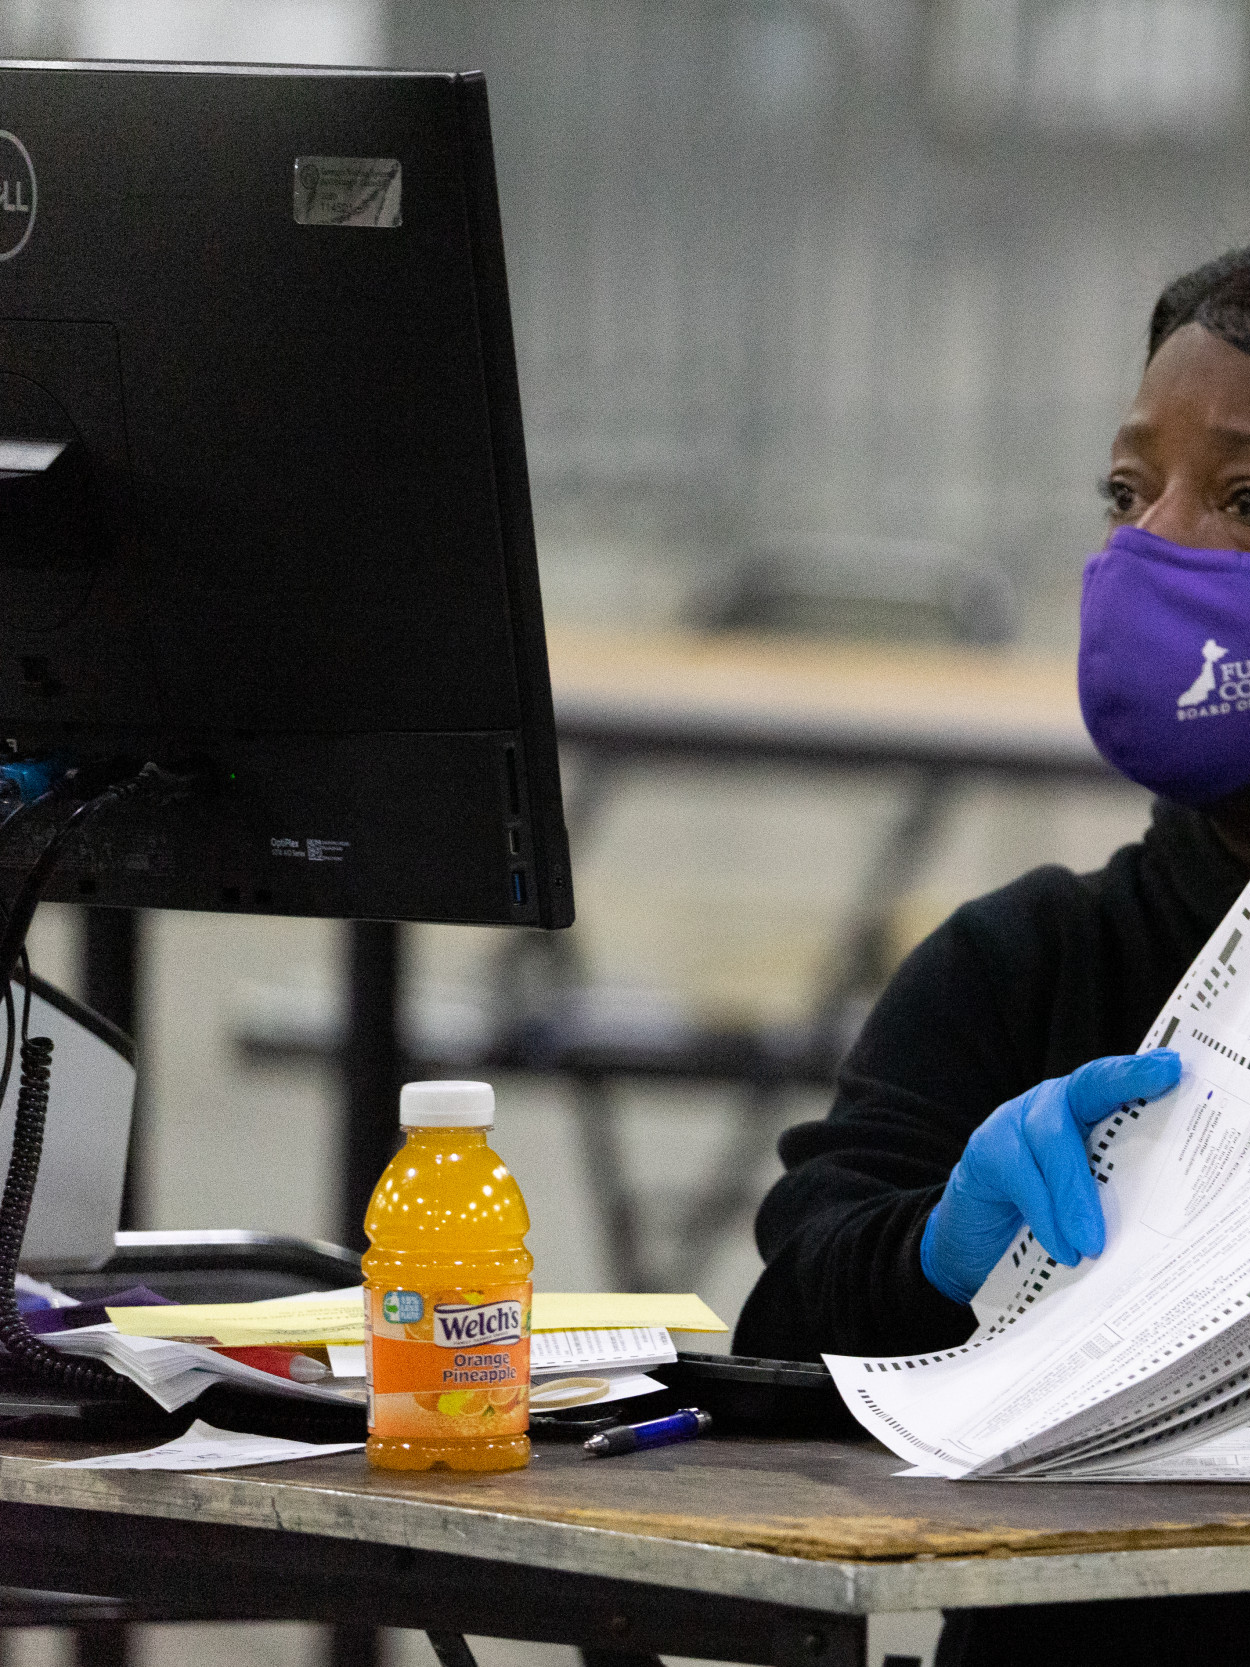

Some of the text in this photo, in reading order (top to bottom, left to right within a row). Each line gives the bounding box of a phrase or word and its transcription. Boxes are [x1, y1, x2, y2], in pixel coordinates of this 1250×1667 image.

[1177, 702, 1230, 721] BOARD
[1210, 1111, 1221, 1128] Kelly
[1177, 1102, 1208, 1162] Raphael Warnock
[438, 1306, 519, 1341] Welch's
[454, 1353, 510, 1369] Orange
[442, 1366, 517, 1384] Pineapple
